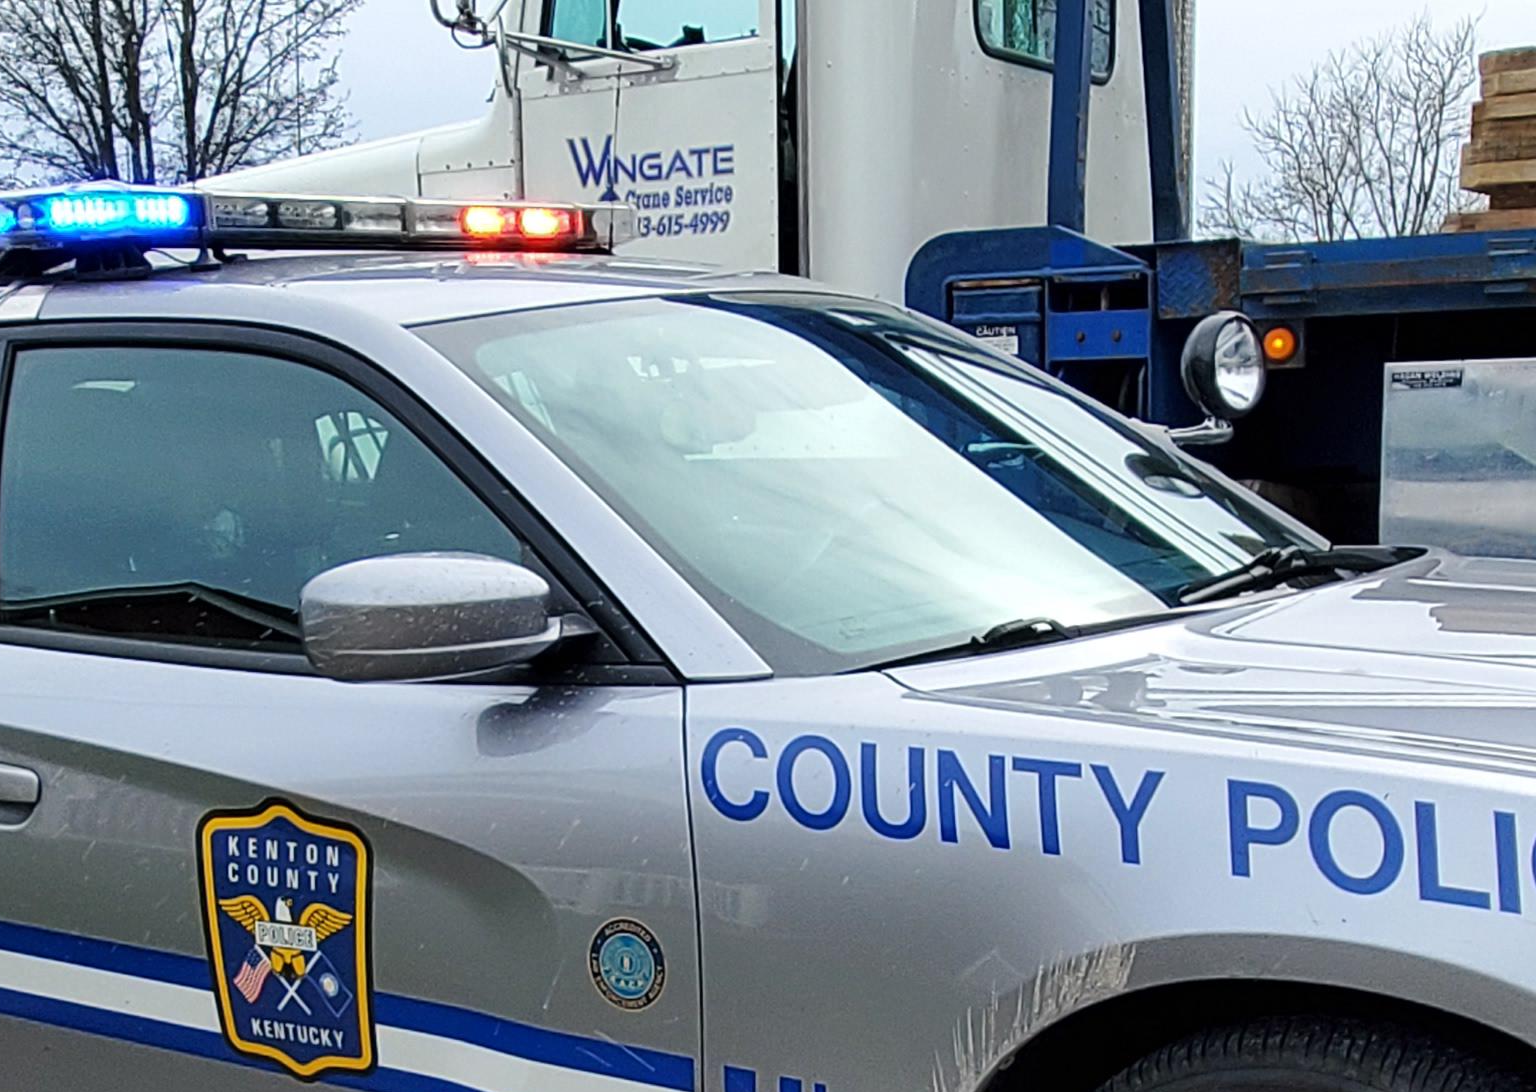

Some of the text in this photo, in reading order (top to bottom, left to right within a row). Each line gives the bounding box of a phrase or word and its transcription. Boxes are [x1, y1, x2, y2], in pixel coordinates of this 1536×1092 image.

[625, 182, 734, 210] Crane Service
[700, 727, 1166, 865] COUNTY
[228, 836, 339, 867] KENTON
[228, 862, 339, 893] COUNTY
[258, 923, 315, 948] POLICE
[251, 1018, 344, 1049] KENTUCKY
